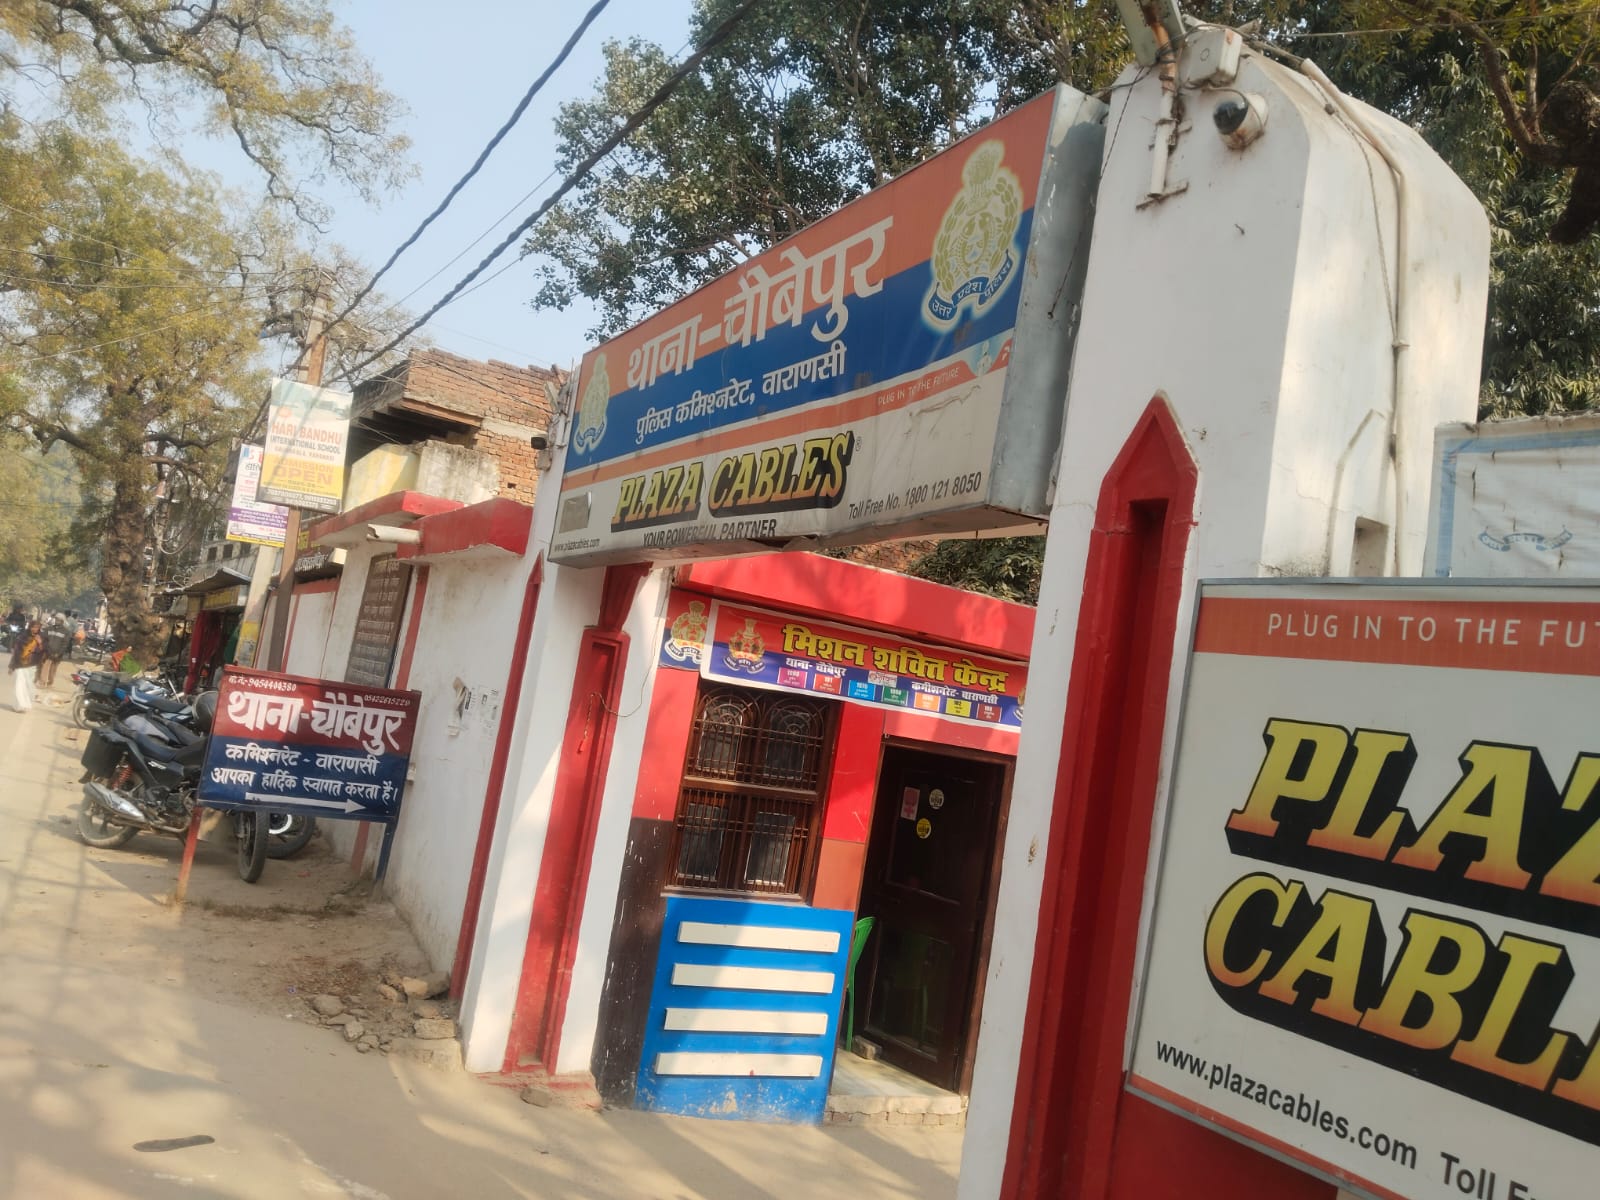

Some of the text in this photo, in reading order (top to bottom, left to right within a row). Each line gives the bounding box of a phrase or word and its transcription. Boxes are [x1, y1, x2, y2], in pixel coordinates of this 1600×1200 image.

[636, 407, 674, 444] पुलिस
[675, 378, 755, 423] कमिश्नरेट,
[762, 340, 847, 397] वाराणसी
[878, 391, 895, 405] PLUG
[897, 389, 905, 400] IN
[300, 427, 342, 445] BANDHU
[318, 443, 341, 454] SCHOOL
[273, 467, 332, 485] OPEN
[611, 431, 855, 532] PLAZA CABLES
[849, 471, 982, 520] Toll Free No. 1800 121 8050
[643, 530, 665, 547] YOUR
[720, 519, 777, 540] PARTNER
[1267, 612, 1339, 639] PLUG
[1352, 614, 1382, 641] IN
[1398, 617, 1437, 643] TO
[1455, 618, 1521, 645] THE
[781, 623, 868, 666] मिशन
[871, 645, 948, 681] शक्ति
[952, 658, 1009, 693] केन्द्र
[225, 742, 301, 766] कमिश्नरेट
[316, 753, 380, 776] वाराणसी
[211, 767, 256, 786] आपका
[261, 768, 298, 792] हार्दिक
[302, 776, 344, 796] स्वागत
[345, 782, 381, 801] करता
[1156, 1040, 1417, 1169] www.plazacables.com
[1440, 1151, 1496, 1200] Toll
